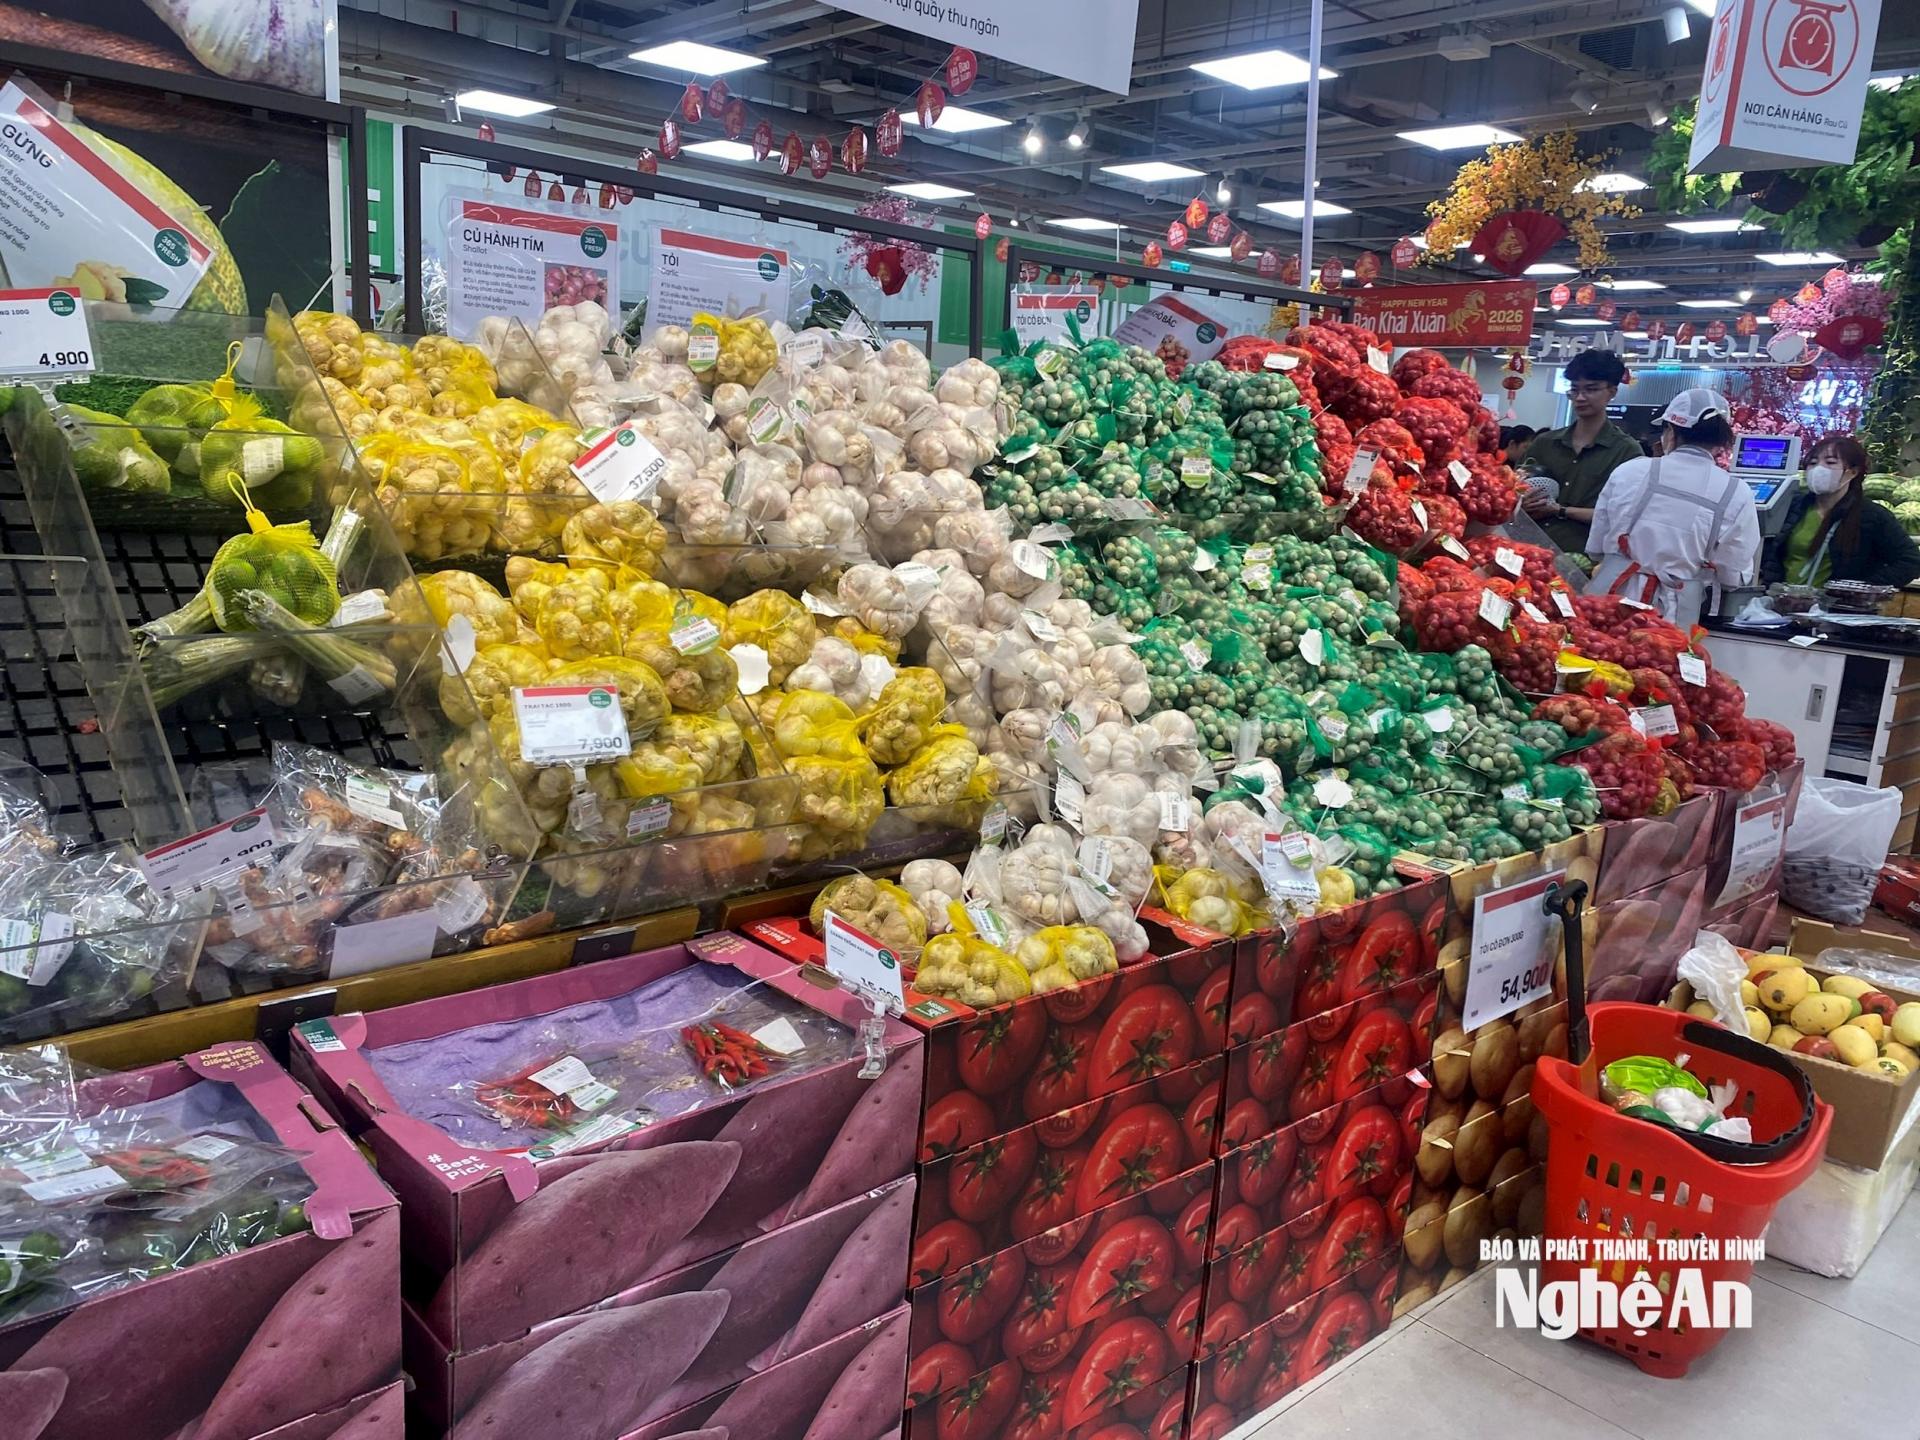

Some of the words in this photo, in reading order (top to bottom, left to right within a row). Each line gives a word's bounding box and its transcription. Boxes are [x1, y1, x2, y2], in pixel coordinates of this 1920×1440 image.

[914, 0, 945, 23] quầy
[948, 8, 967, 27] thu
[970, 18, 1000, 37] ngân
[1744, 102, 1765, 116] NƠI
[1766, 104, 1790, 119] CÂN
[2, 124, 52, 168] GỪNG
[161, 235, 177, 250] 365
[463, 227, 481, 243] CỦ
[484, 230, 520, 250] HÀNH
[522, 236, 544, 253] TÍM
[584, 244, 604, 253] FRESH
[157, 243, 182, 264] FRESH
[463, 245, 488, 255] Shallot
[661, 252, 679, 268] TỎI
[1381, 299, 1406, 308] HAPPY
[1407, 298, 1425, 307] NEW
[1425, 297, 1448, 307] YEAR
[1378, 310, 1409, 334] Khai
[1410, 310, 1446, 333] Xuân
[1488, 309, 1524, 324] 2026
[39, 351, 89, 369] 4,900
[629, 457, 666, 490] 37,500
[578, 736, 623, 752] 7,900
[219, 839, 273, 866] 4900
[1500, 962, 1551, 1004] 54,900
[435, 1155, 482, 1172] Best
[445, 1162, 491, 1181] Pick
